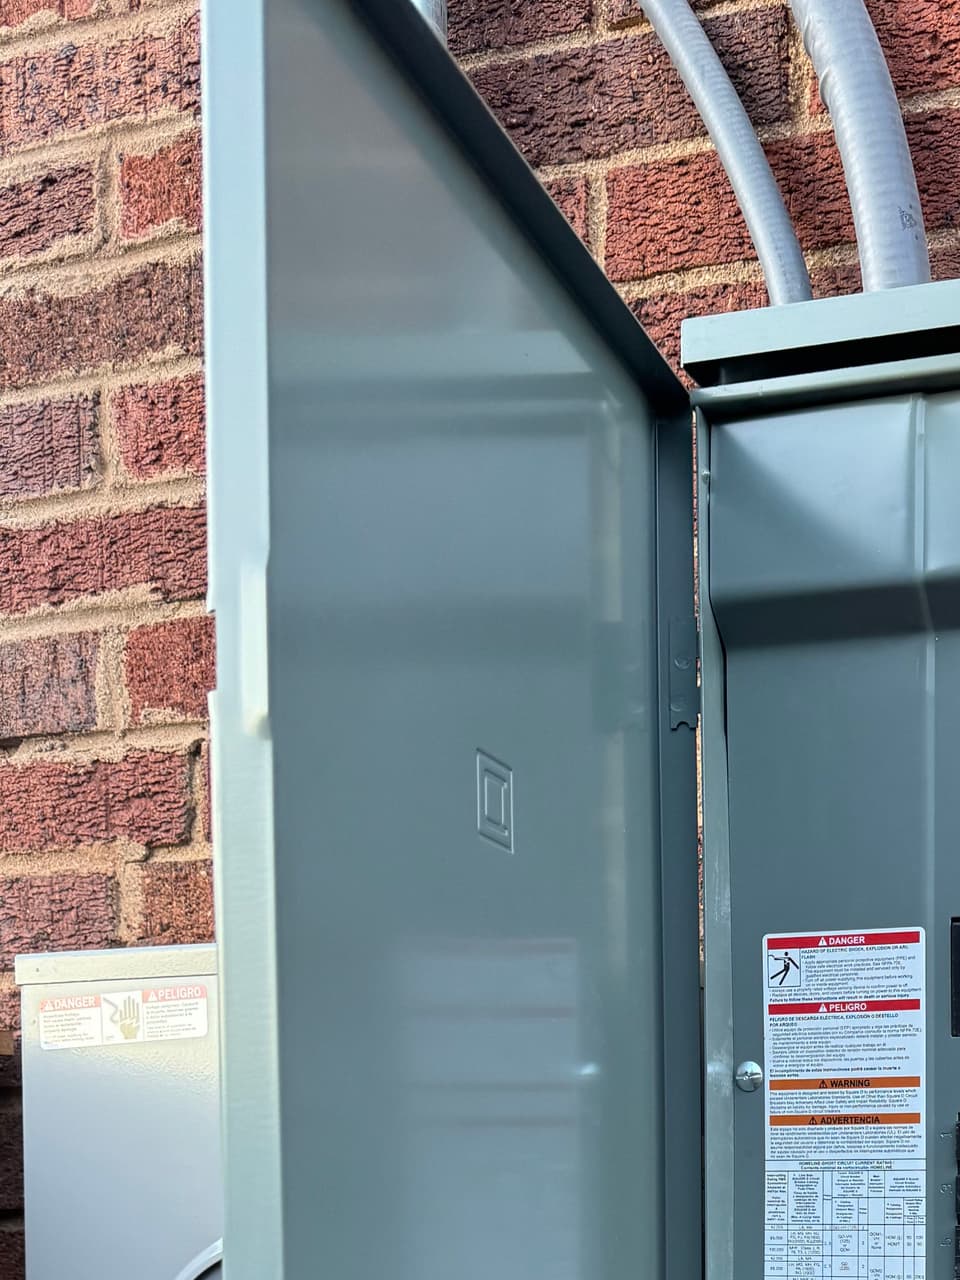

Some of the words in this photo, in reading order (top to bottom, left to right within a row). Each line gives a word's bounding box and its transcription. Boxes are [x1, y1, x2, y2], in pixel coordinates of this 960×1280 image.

[829, 936, 865, 945] DANGER
[158, 987, 200, 1000] PELIGRO
[55, 996, 95, 1008] DANGER
[829, 1004, 867, 1012] PELIGRO
[830, 1080, 870, 1088] WARNING
[821, 1116, 880, 1125] ADVERTENCIA
